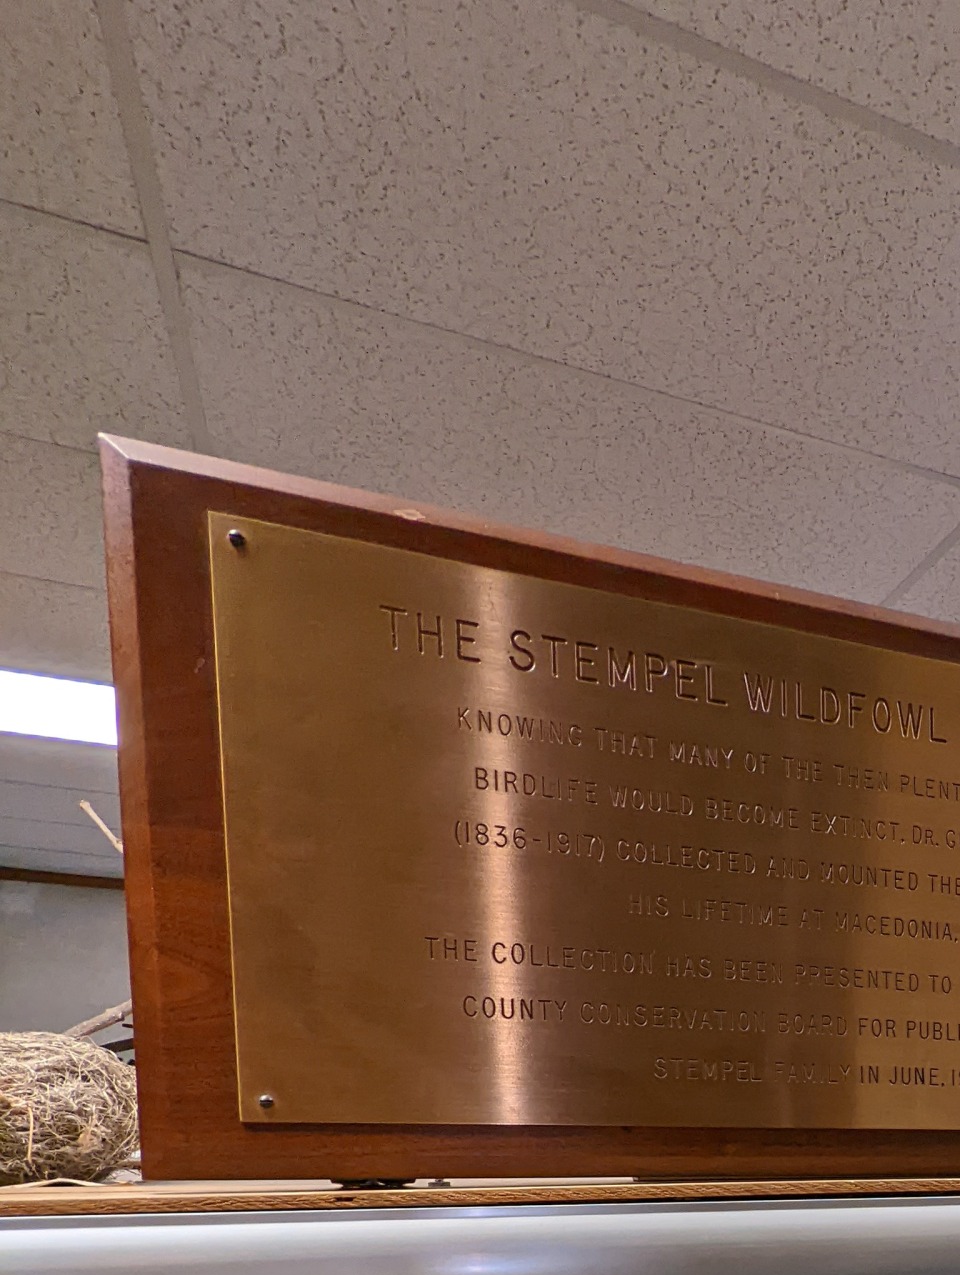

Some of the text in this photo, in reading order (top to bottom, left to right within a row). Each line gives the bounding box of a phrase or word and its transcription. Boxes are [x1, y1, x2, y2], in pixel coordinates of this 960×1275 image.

[380, 604, 482, 664] THE
[508, 630, 728, 706] STEMPEL
[744, 672, 948, 744] WILDFOWL
[457, 706, 582, 748] KNOWING
[593, 727, 658, 758] THAT
[668, 740, 734, 769] MANY
[744, 751, 772, 774] OF
[782, 756, 823, 782] THE
[832, 764, 890, 792] THEN
[474, 766, 598, 806] BIRDLIFE
[608, 784, 694, 818] WOULD
[705, 797, 800, 830] BECOME
[912, 824, 940, 848] DR.
[454, 820, 605, 863] (1836-1917)
[616, 838, 756, 875] COLLECTED
[766, 856, 810, 881] AND
[820, 861, 920, 892] MOUNTED
[628, 892, 670, 918] HIS
[680, 898, 789, 928] LIFETIME
[799, 908, 825, 930] AT
[424, 936, 478, 962] THE
[491, 942, 656, 974] COLLECTION
[666, 954, 712, 980] HAS
[723, 958, 784, 984] BEEN
[794, 964, 920, 993] PRESENTED
[928, 974, 952, 996] TO
[462, 995, 568, 1020] COUNTY
[580, 1002, 766, 1034] CONSERVATION
[778, 1012, 848, 1037] BOARD
[858, 1017, 896, 1040] FOR
[653, 1056, 763, 1082] STEMPEL
[774, 1060, 850, 1085] FAMILY
[860, 1066, 879, 1085] IN
